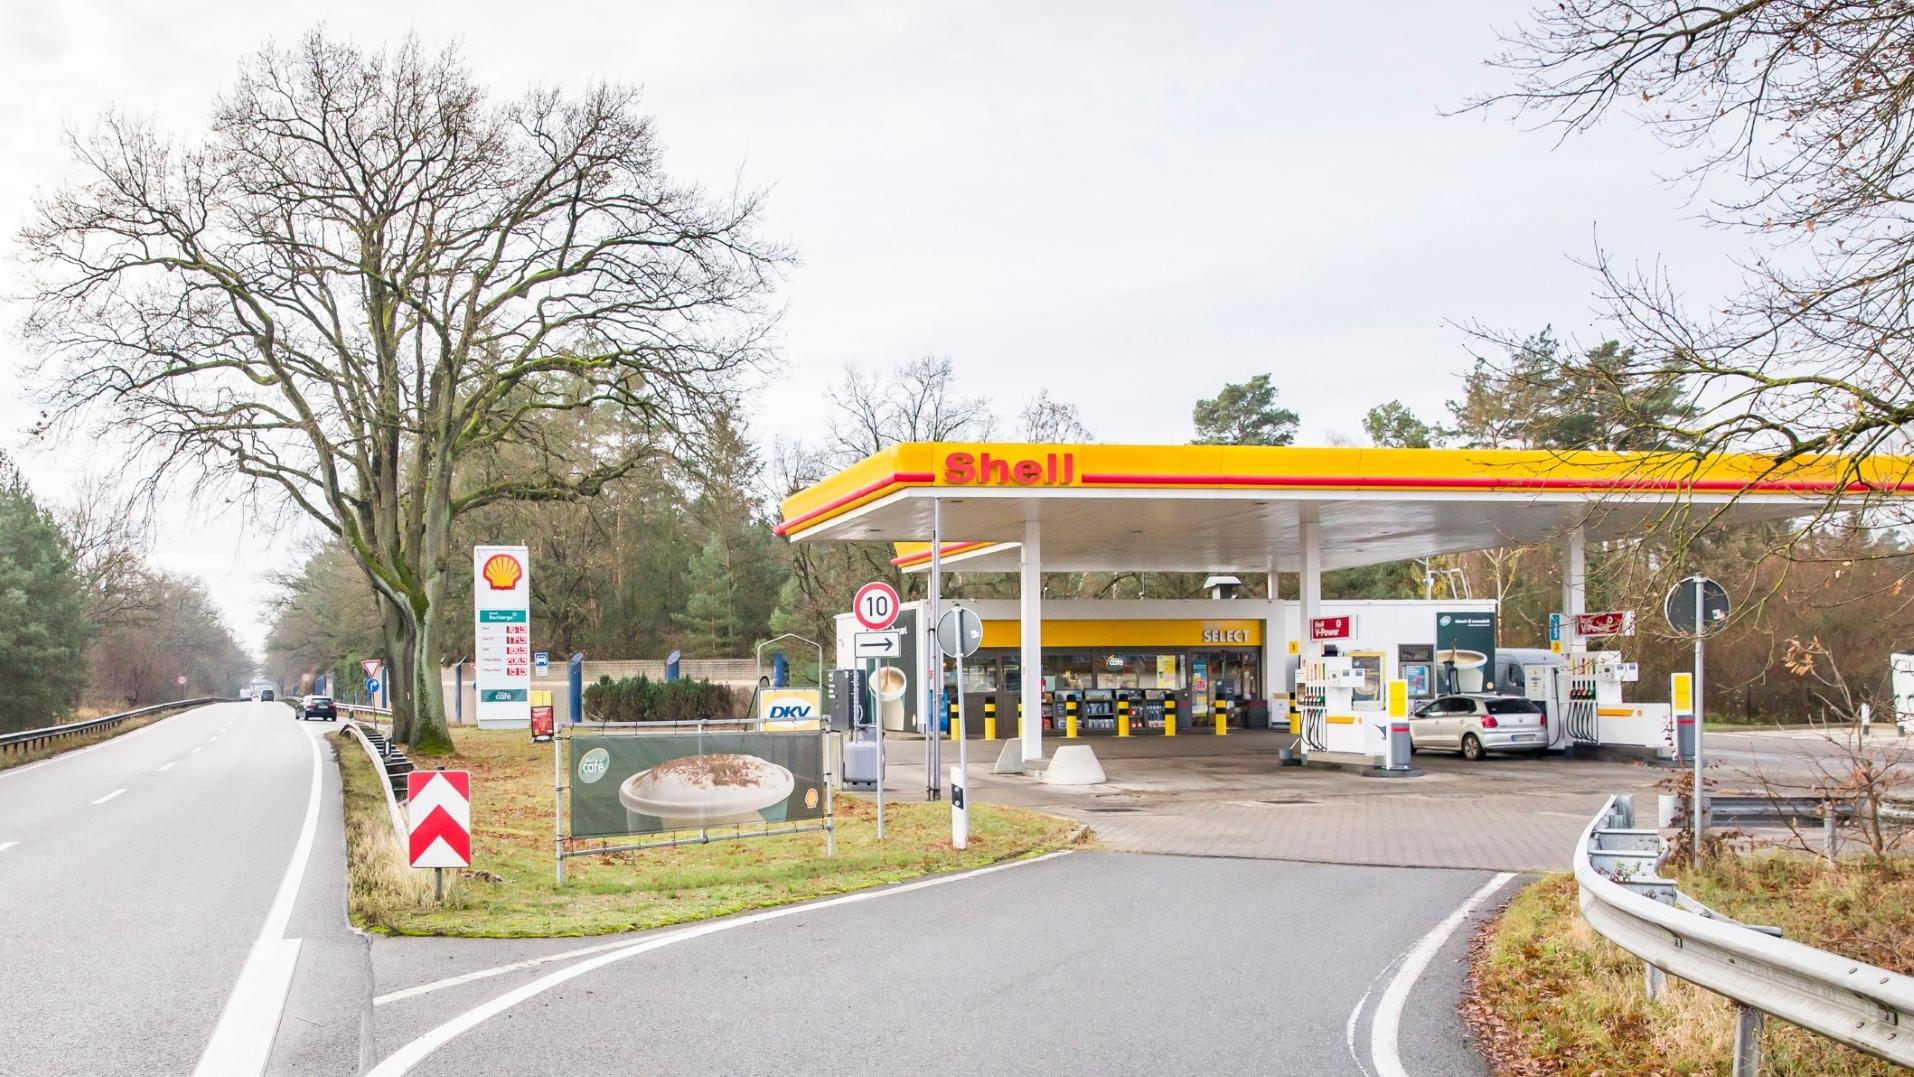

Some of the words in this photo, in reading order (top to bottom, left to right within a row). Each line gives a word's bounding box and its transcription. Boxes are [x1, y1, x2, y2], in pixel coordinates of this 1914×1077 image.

[944, 452, 1074, 484] Shell
[866, 596, 888, 617] 10
[1203, 630, 1250, 643] SELECT
[1314, 628, 1340, 637] V-Power
[770, 705, 812, 718] DKV
[583, 758, 606, 773] café
